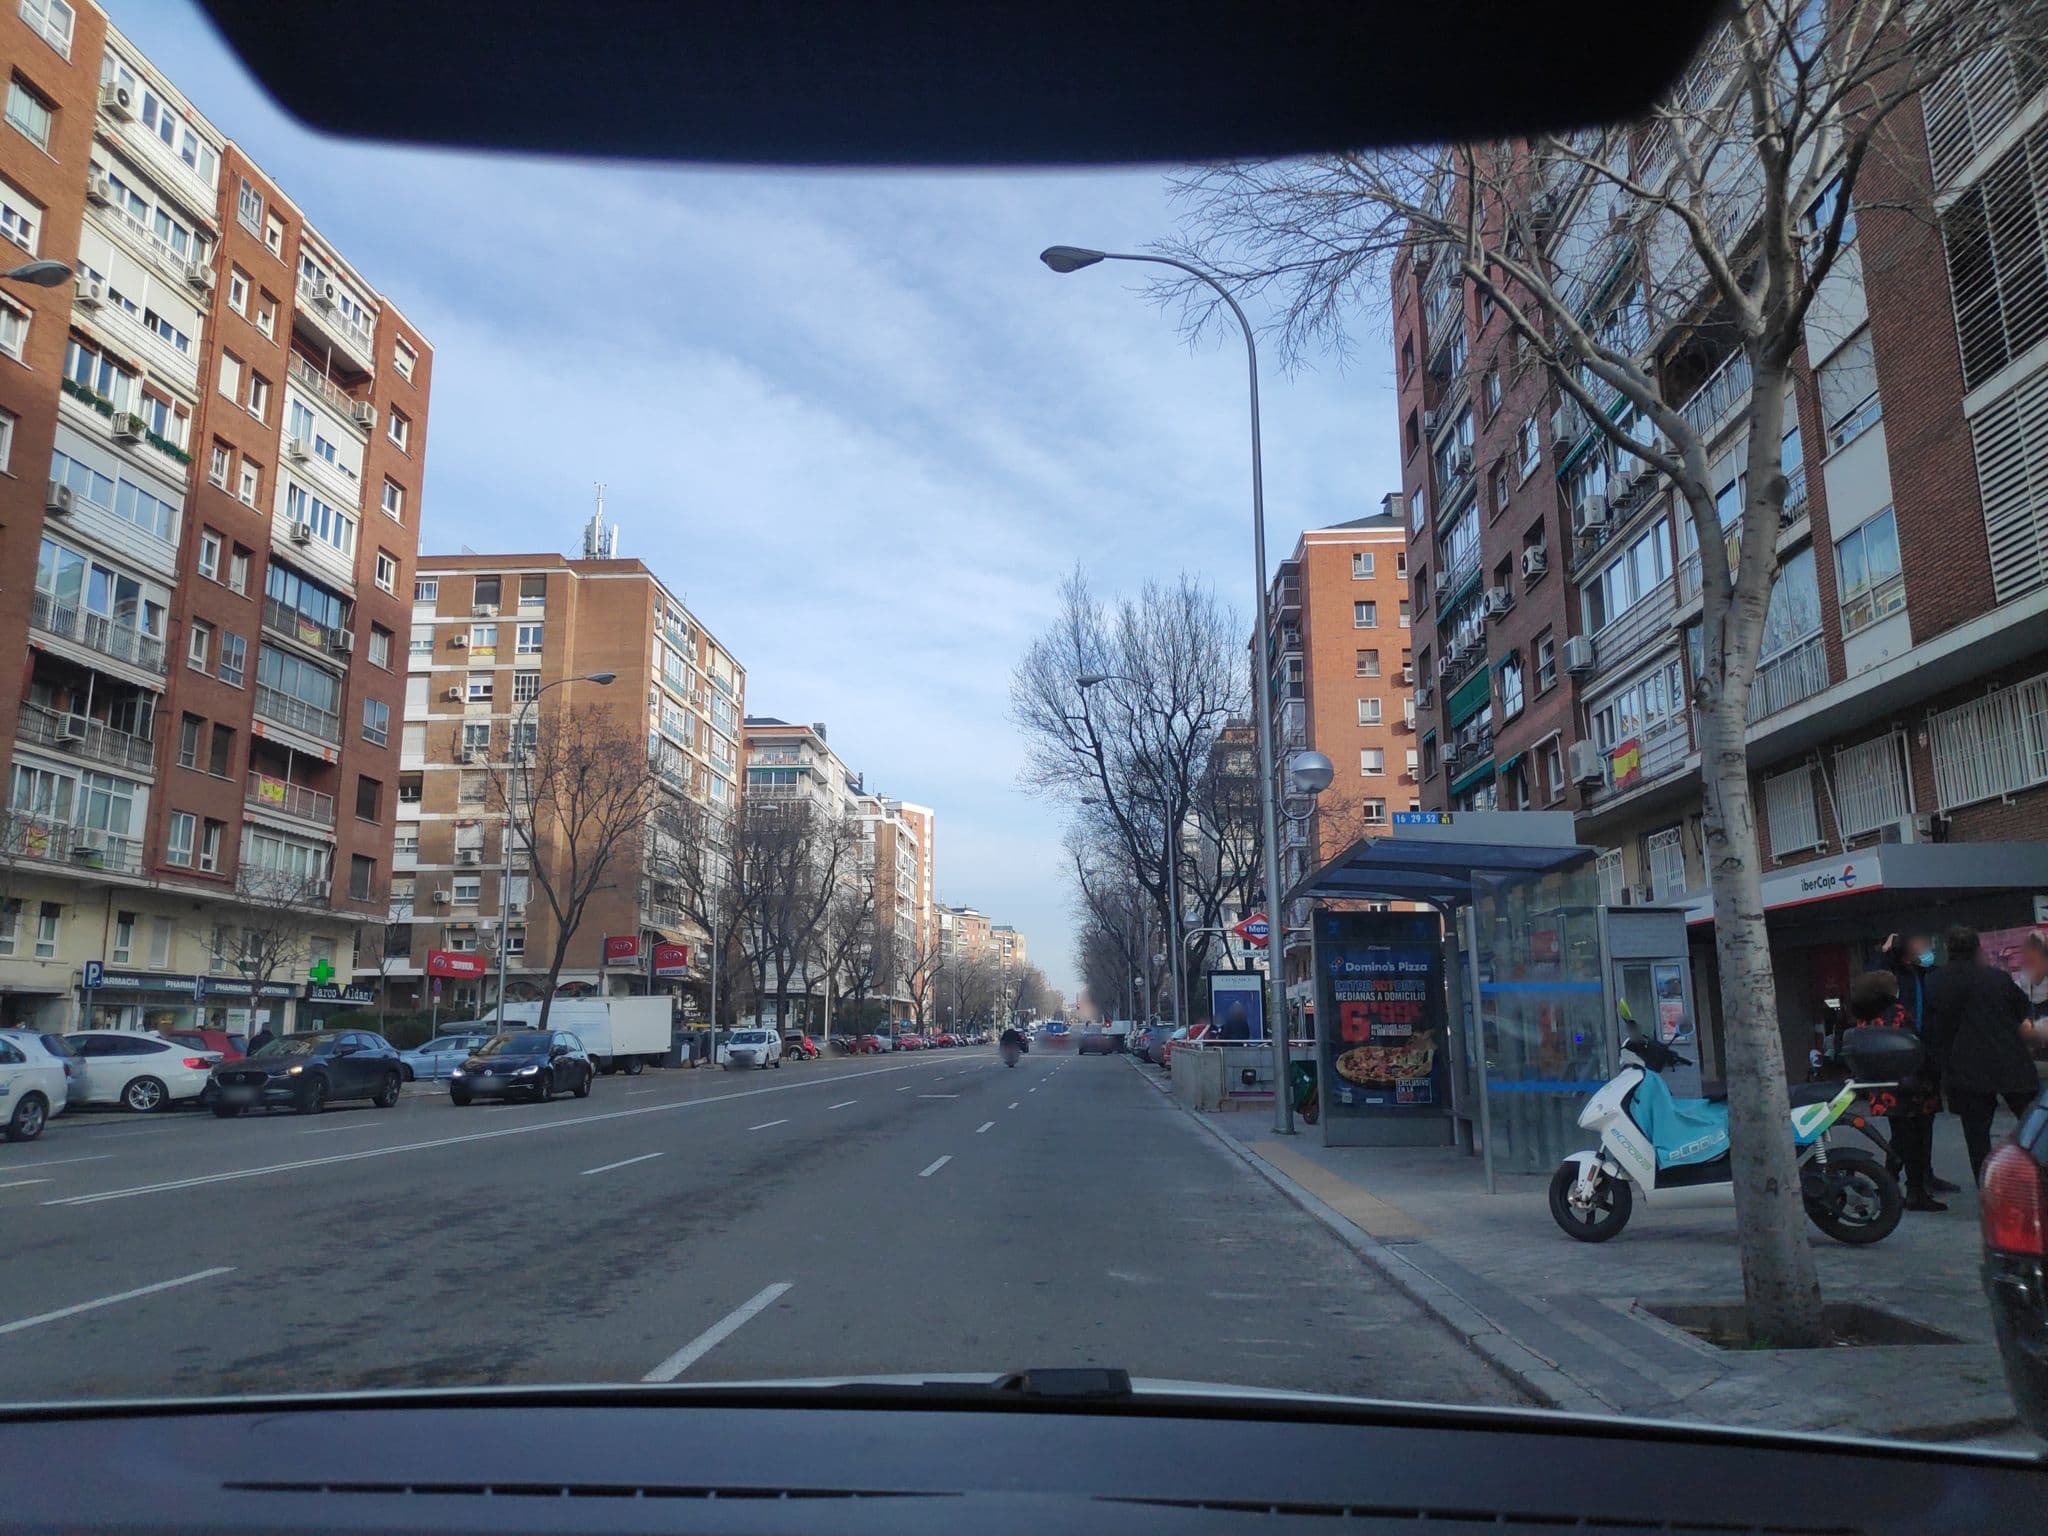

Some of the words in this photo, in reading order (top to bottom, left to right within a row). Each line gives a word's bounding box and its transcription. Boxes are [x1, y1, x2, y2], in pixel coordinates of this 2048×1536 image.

[1396, 814, 1406, 823] 16
[1411, 814, 1421, 823] 29
[1425, 814, 1436, 823] 52
[1801, 874, 1836, 891] iberCaja
[1345, 962, 1395, 972] Domino's
[1398, 961, 1428, 972] Pizza
[88, 963, 100, 985] P
[311, 985, 337, 998] Marco
[344, 989, 374, 1003] Aldany
[1335, 992, 1376, 1001] MEDIANAS
[1377, 992, 1383, 1001] A
[1384, 992, 1426, 1001] DOMICILIO
